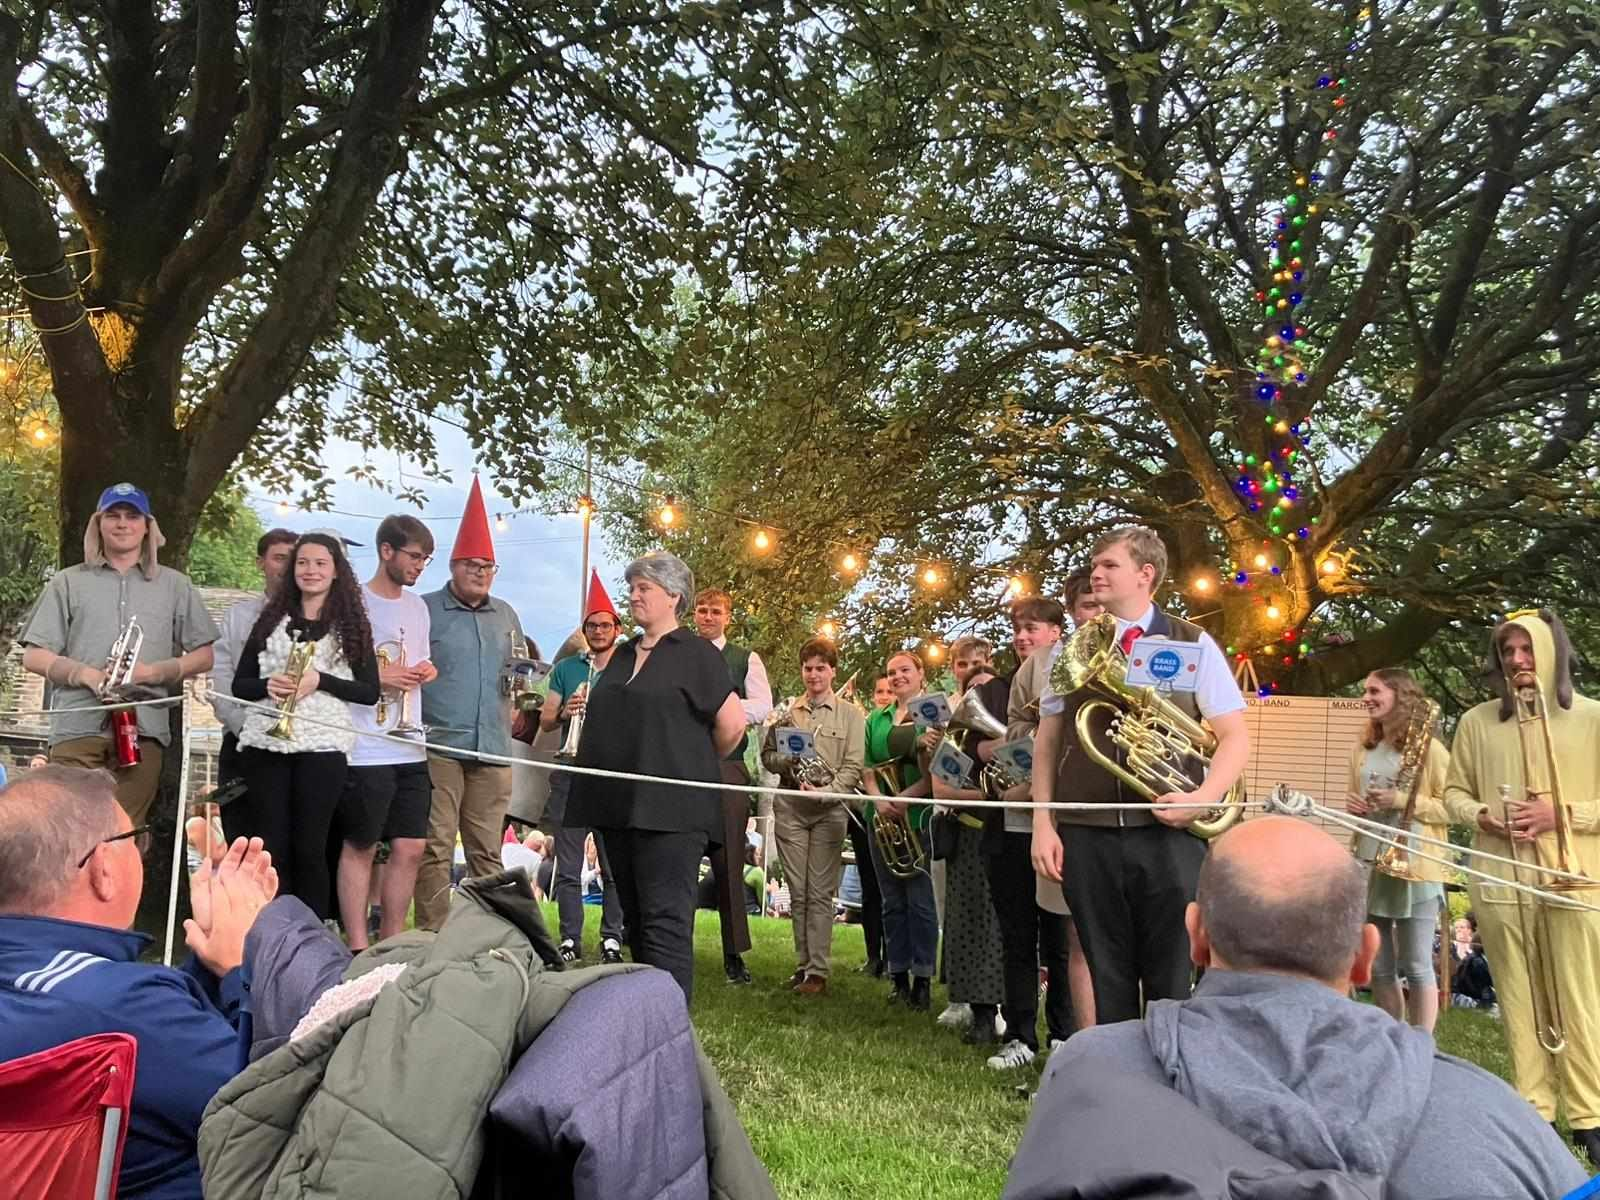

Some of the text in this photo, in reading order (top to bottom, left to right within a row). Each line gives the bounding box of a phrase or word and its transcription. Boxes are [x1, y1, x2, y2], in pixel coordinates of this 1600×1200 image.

[1154, 657, 1177, 666] BRASS
[1263, 699, 1290, 708] BAND
[1332, 701, 1367, 710] MARCH
